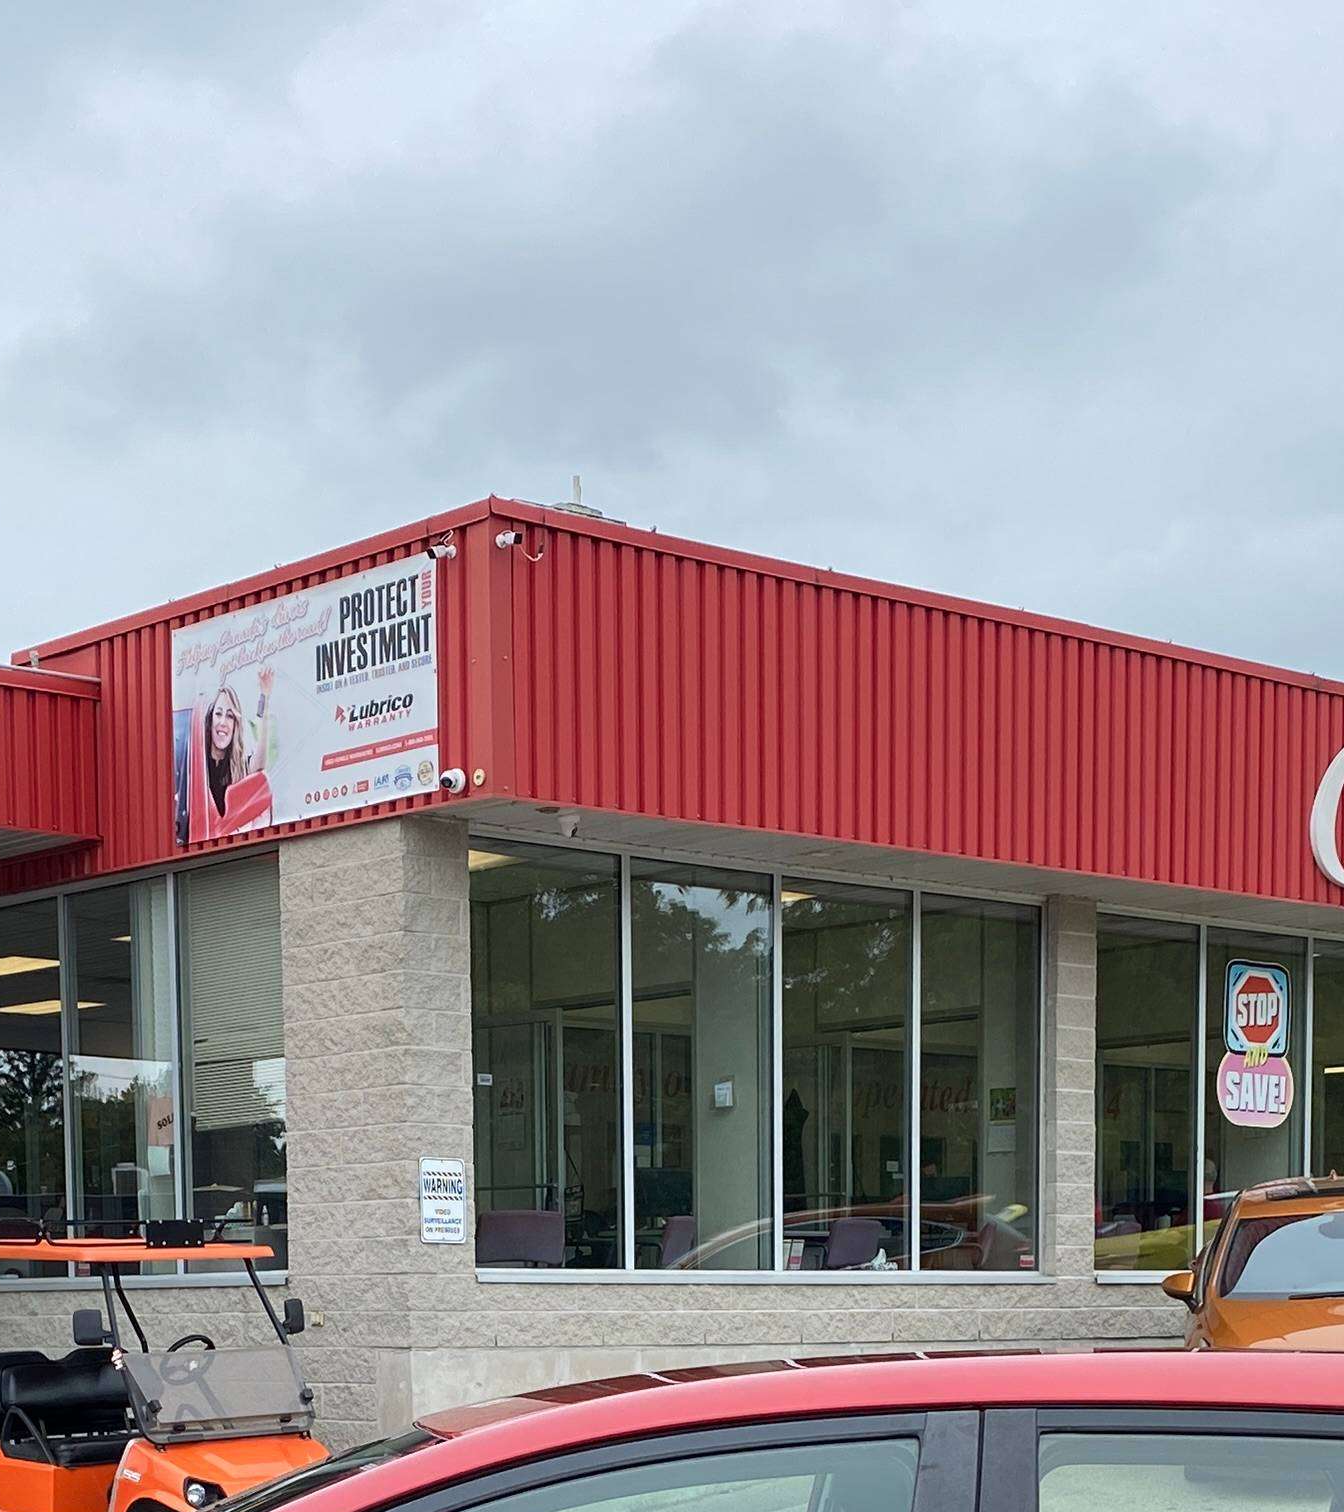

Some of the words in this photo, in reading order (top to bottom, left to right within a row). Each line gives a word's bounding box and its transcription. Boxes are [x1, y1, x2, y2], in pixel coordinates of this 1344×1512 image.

[340, 574, 419, 634] PROTECT
[316, 613, 432, 682] INVESTMENT
[348, 693, 414, 722] Lubrico
[348, 709, 412, 731] WARRANTY
[1237, 992, 1279, 1028] STOP
[1244, 1045, 1269, 1068] AND
[1226, 1071, 1287, 1115] SAVE!
[157, 1113, 174, 1130] SOL
[423, 1178, 463, 1195] WARNING
